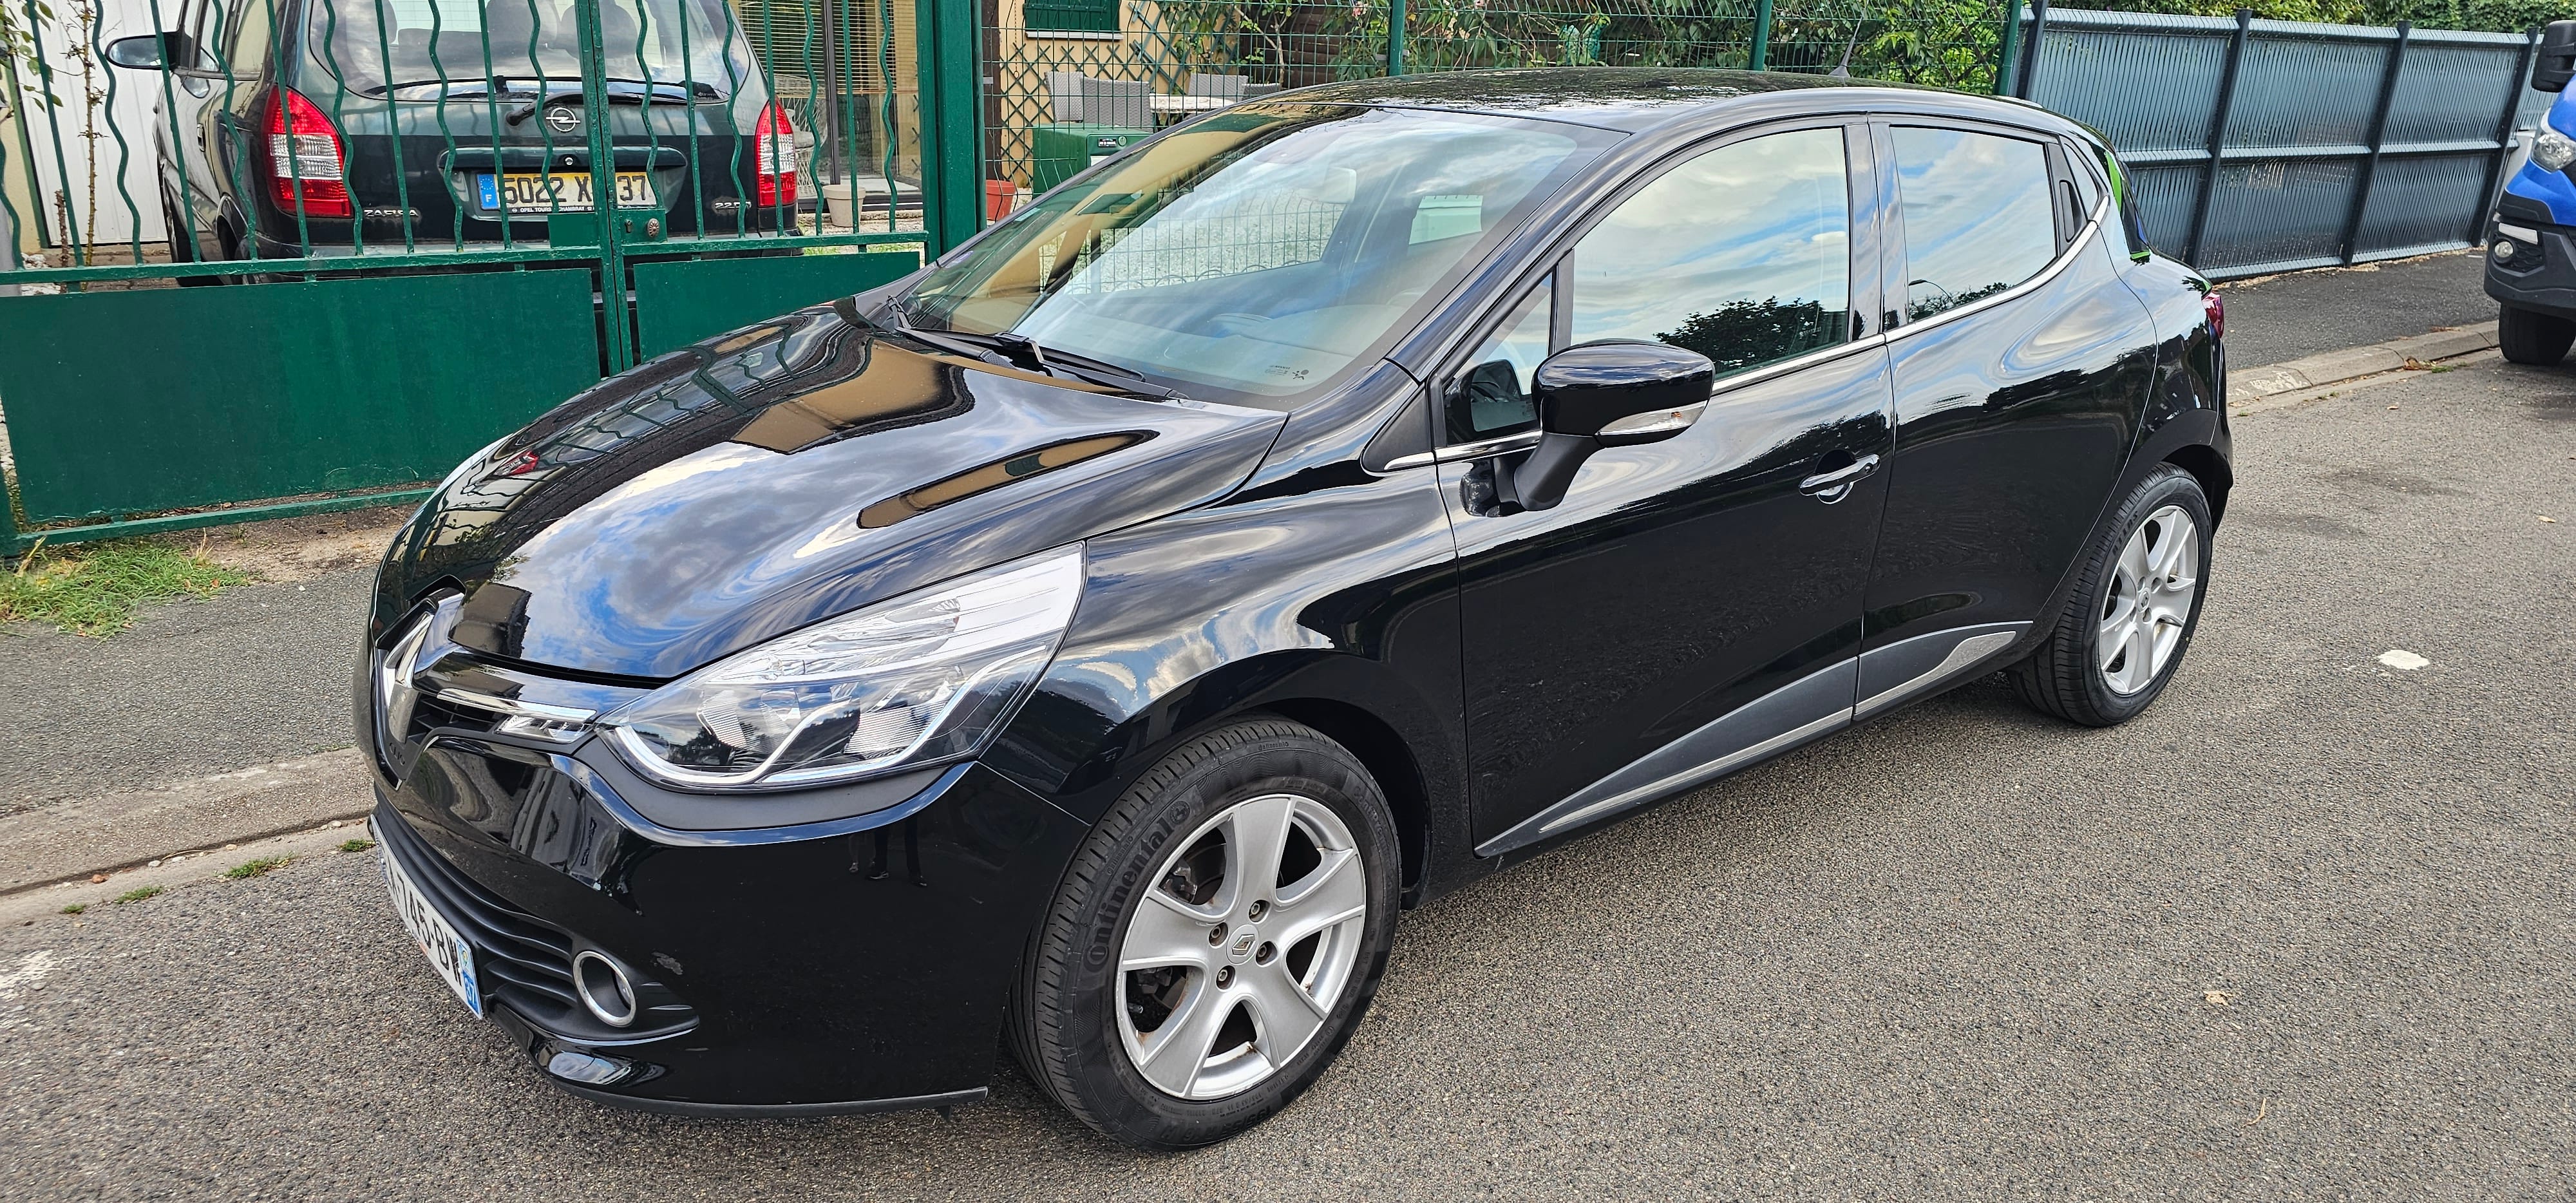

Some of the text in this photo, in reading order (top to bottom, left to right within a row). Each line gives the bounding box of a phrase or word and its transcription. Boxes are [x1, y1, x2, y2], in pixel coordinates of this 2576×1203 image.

[485, 194, 493, 203] F
[503, 175, 646, 204] 5022 X 37
[1083, 817, 1175, 972] Continental
[464, 977, 475, 1005] 37
